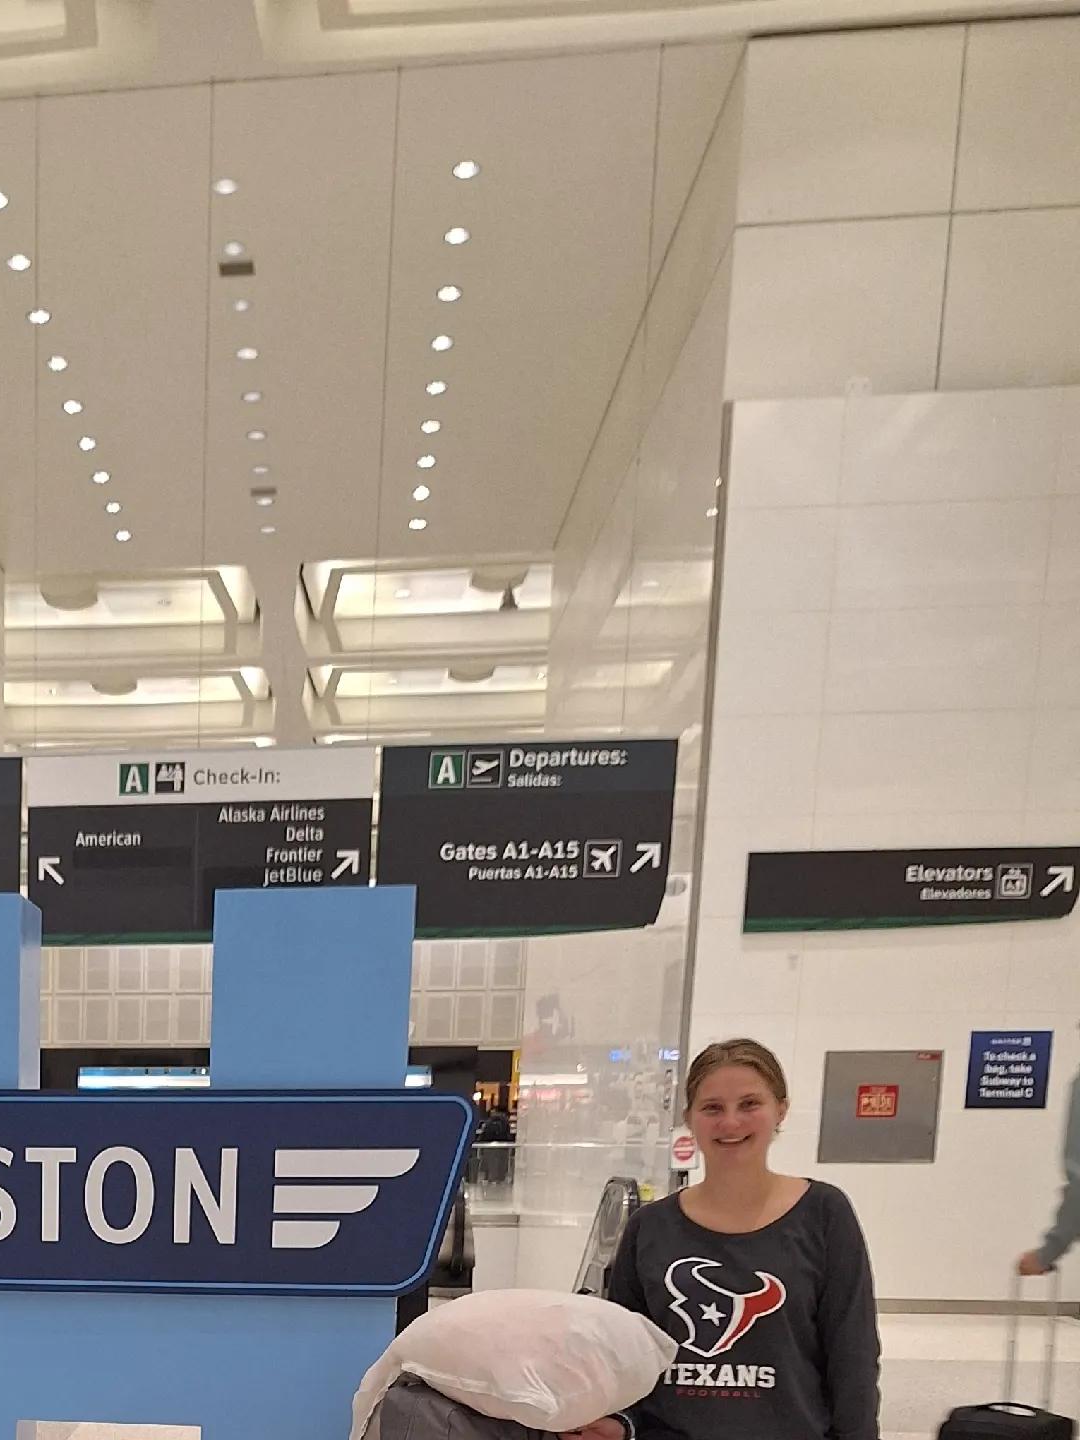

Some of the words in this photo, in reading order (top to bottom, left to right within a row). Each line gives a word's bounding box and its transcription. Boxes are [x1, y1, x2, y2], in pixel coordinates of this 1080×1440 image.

[509, 749, 627, 771] Departures:
[193, 767, 281, 784] Check-In:
[436, 757, 457, 783] A
[124, 767, 145, 793] A
[507, 773, 562, 788] Salidas:
[218, 806, 266, 822] Alaska
[270, 805, 325, 822] Airlines
[75, 830, 142, 848] American
[286, 826, 324, 842] Delta
[266, 846, 323, 862] Frontier
[440, 843, 497, 862] Gates
[502, 841, 580, 860] A1-A15
[468, 866, 521, 881] Puertas
[524, 864, 578, 879] A1-A15
[905, 864, 993, 882] Elevators
[920, 886, 992, 900] Elevadores
[664, 1363, 776, 1388] TEXANS
[676, 1389, 761, 1398] FOOTBALL
